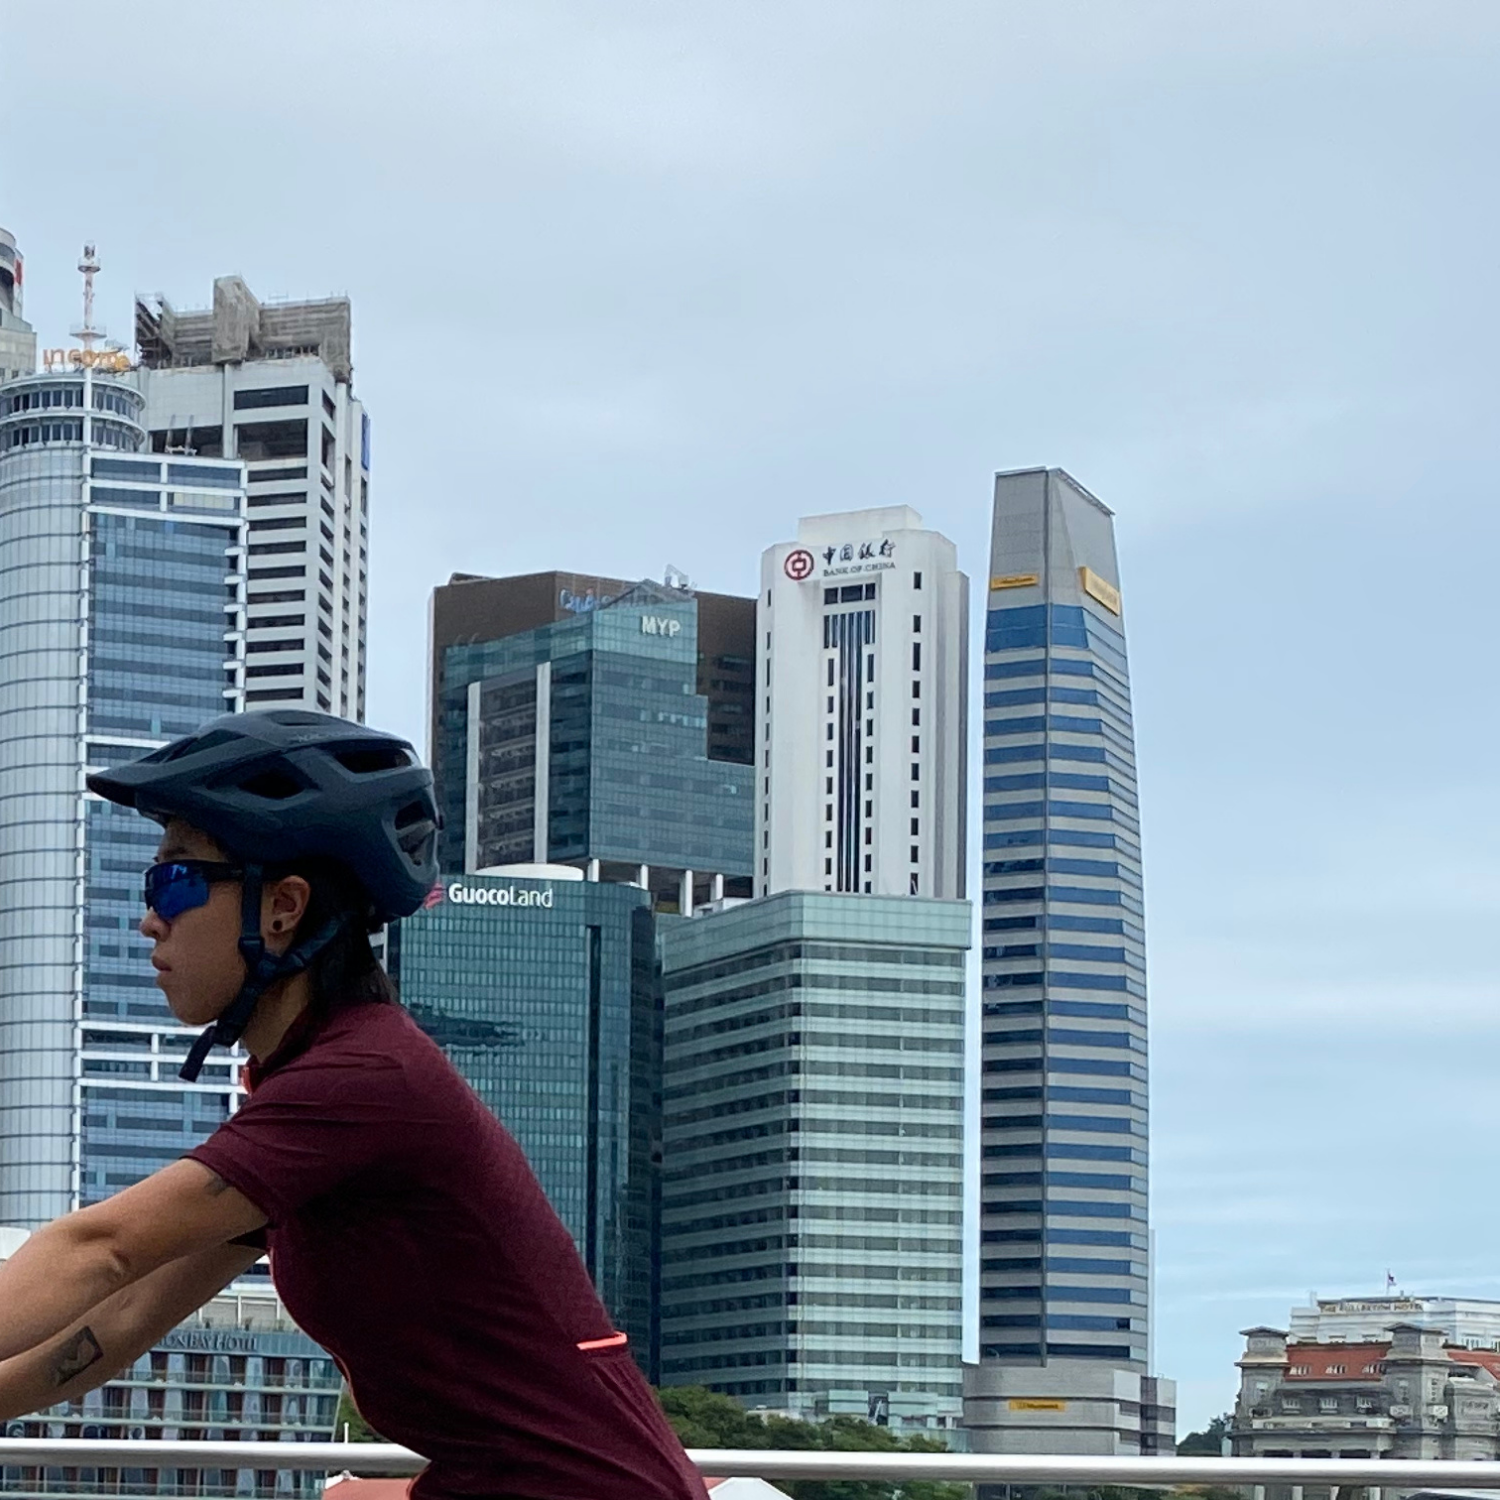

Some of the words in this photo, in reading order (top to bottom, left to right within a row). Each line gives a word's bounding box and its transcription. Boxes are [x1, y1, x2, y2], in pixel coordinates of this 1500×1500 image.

[823, 567, 848, 577] BANK
[865, 562, 896, 571] CHINA
[641, 615, 681, 637] MYP
[448, 883, 553, 908] GuocoLand
